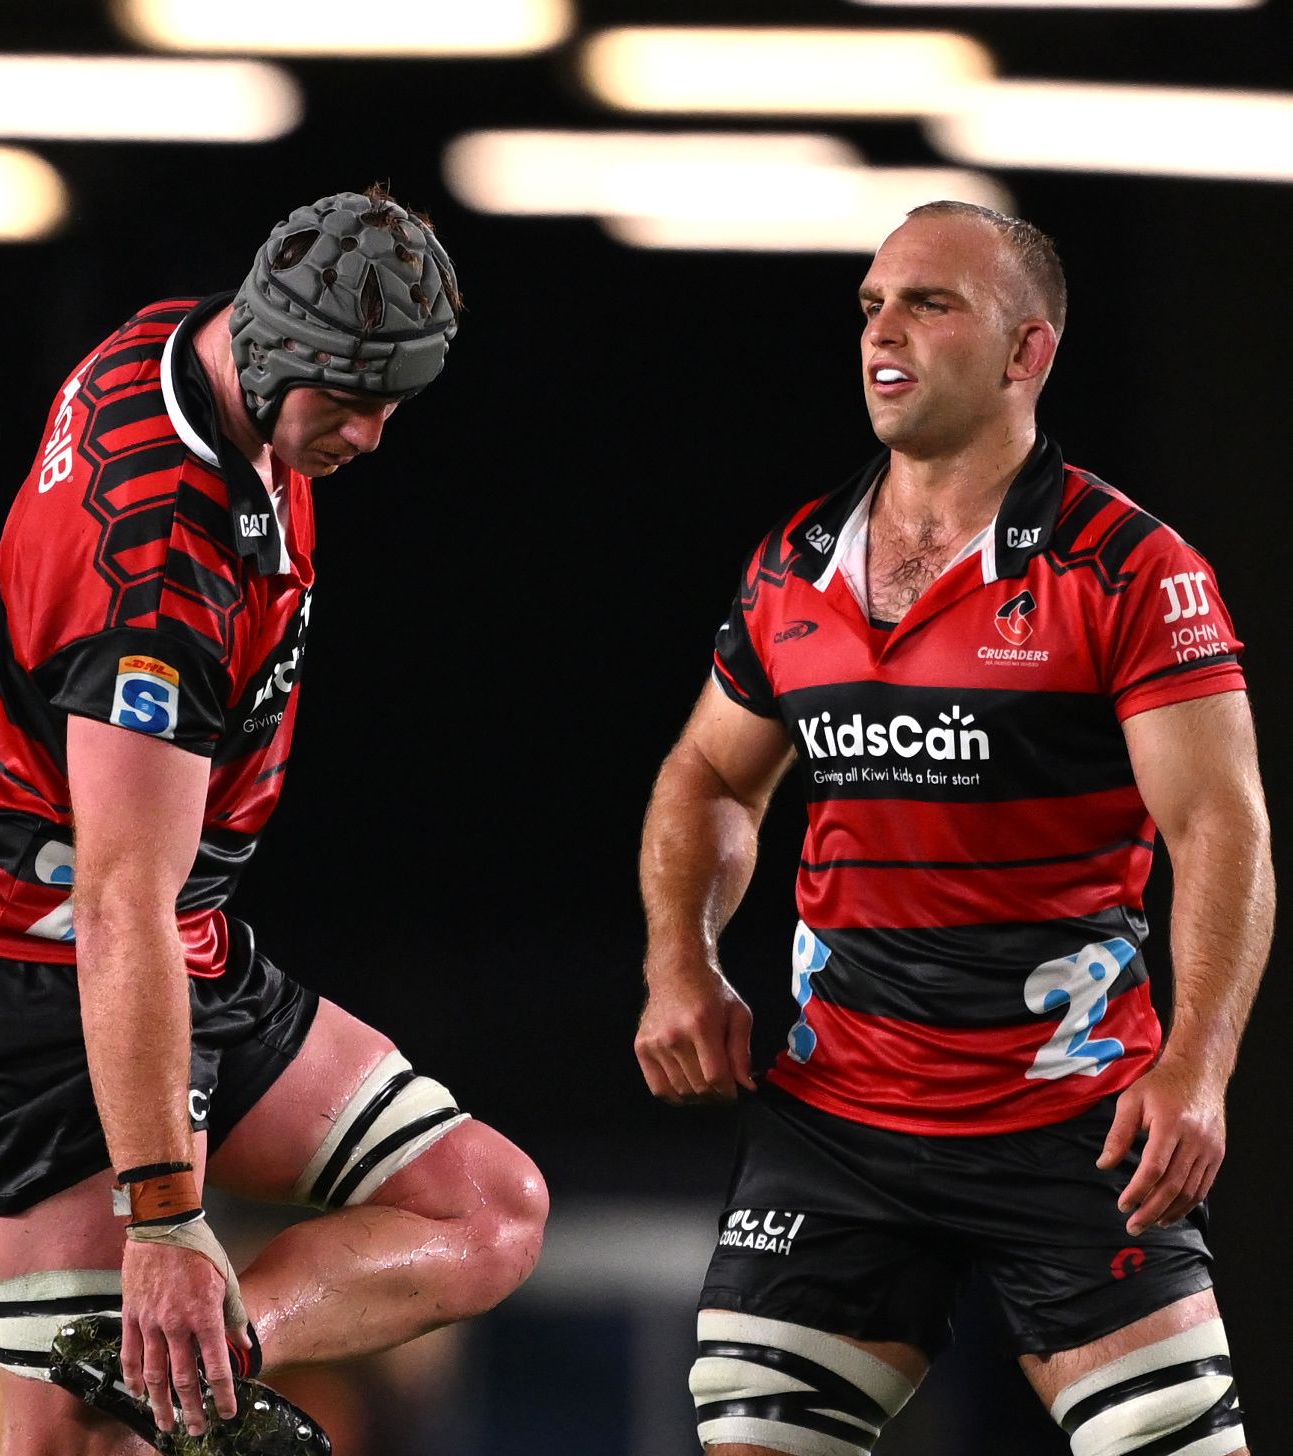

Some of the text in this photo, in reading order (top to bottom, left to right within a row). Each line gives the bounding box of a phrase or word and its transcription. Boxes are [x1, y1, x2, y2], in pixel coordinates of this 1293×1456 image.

[239, 513, 270, 537] CAT
[1006, 526, 1042, 549] CAT
[1170, 623, 1219, 649] JOHN
[977, 646, 1049, 662] CRUSADERS
[243, 711, 284, 733] Giving
[798, 705, 990, 761] KidsCan
[813, 766, 980, 786] Giving all Kiwi kids a fair start
[719, 1229, 792, 1256] COOLABAH
